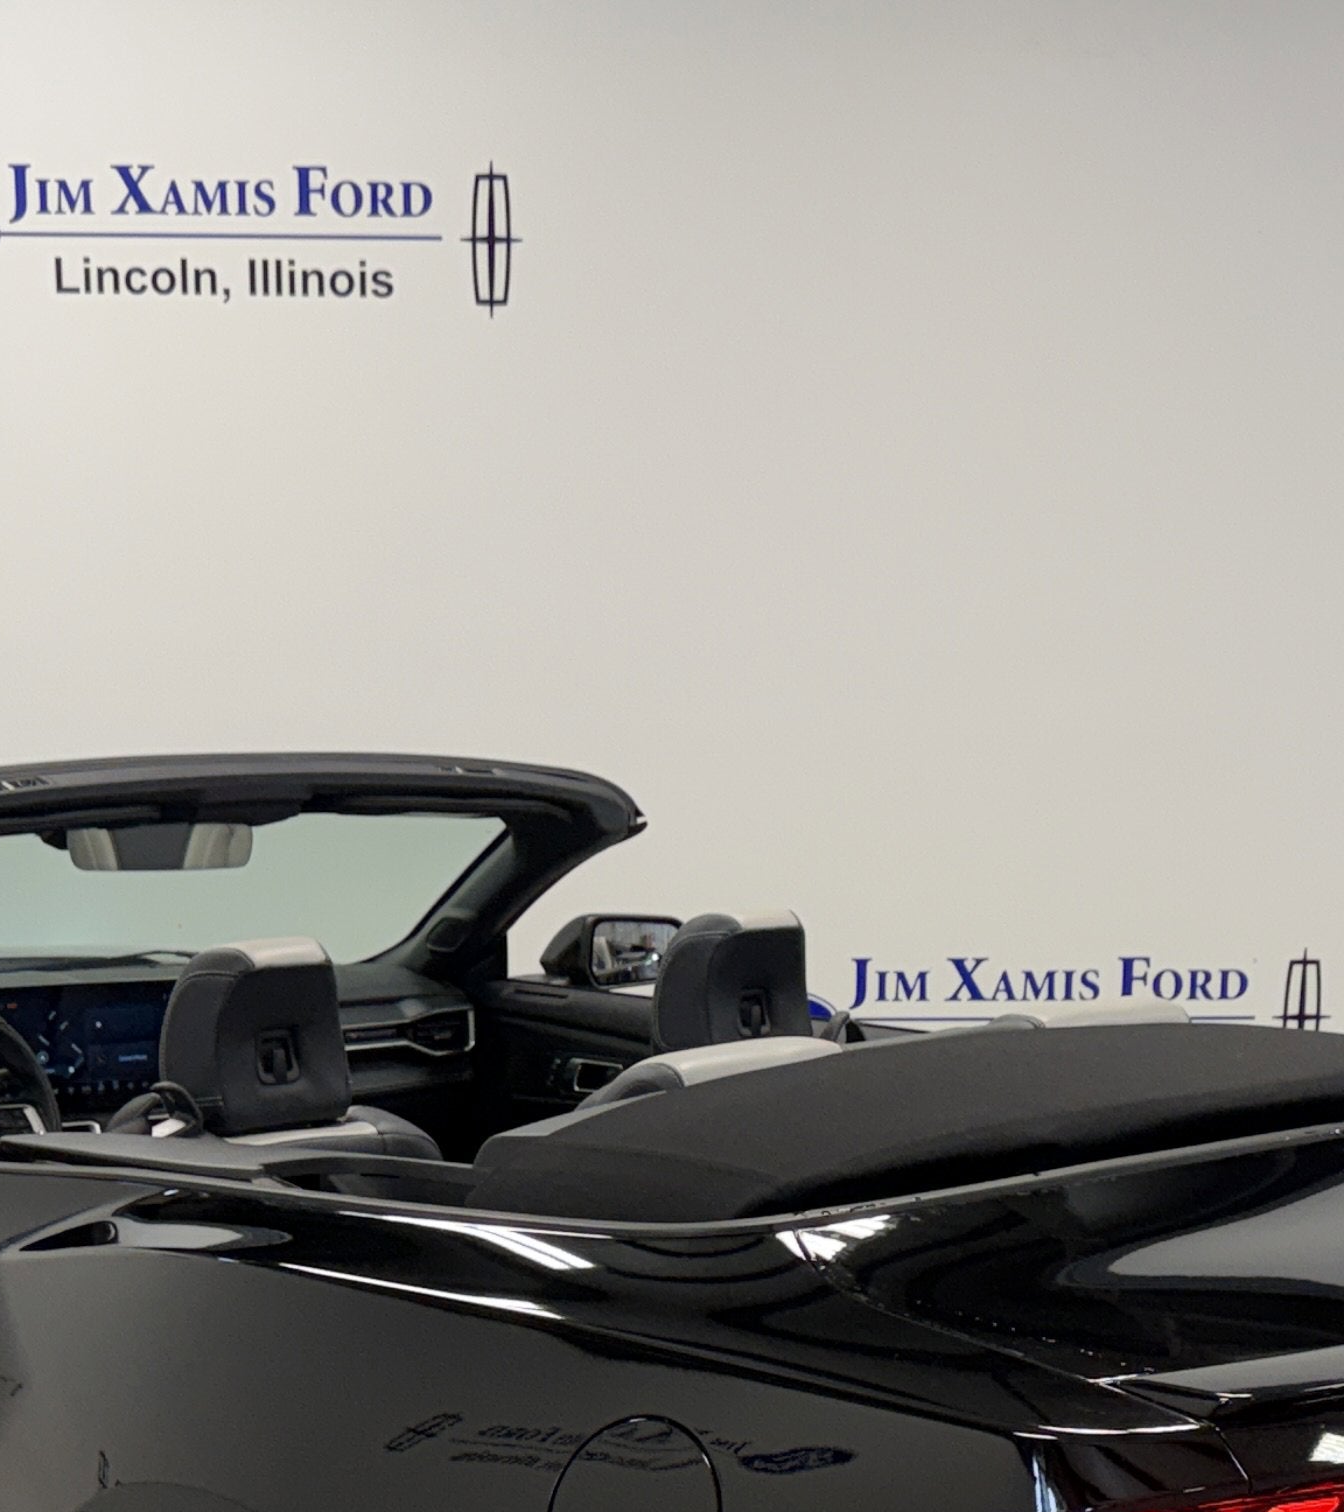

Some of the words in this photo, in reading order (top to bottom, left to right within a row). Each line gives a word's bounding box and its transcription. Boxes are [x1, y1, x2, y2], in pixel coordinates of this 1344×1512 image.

[7, 163, 96, 225] JIM
[109, 164, 277, 218] XAMIS
[292, 165, 434, 219] FORD
[54, 256, 232, 305] Lincoln,
[247, 257, 396, 300] Illinois
[849, 957, 930, 1009] JIM
[943, 957, 1101, 1002] XAMIS
[1117, 956, 1250, 1002] FORD
